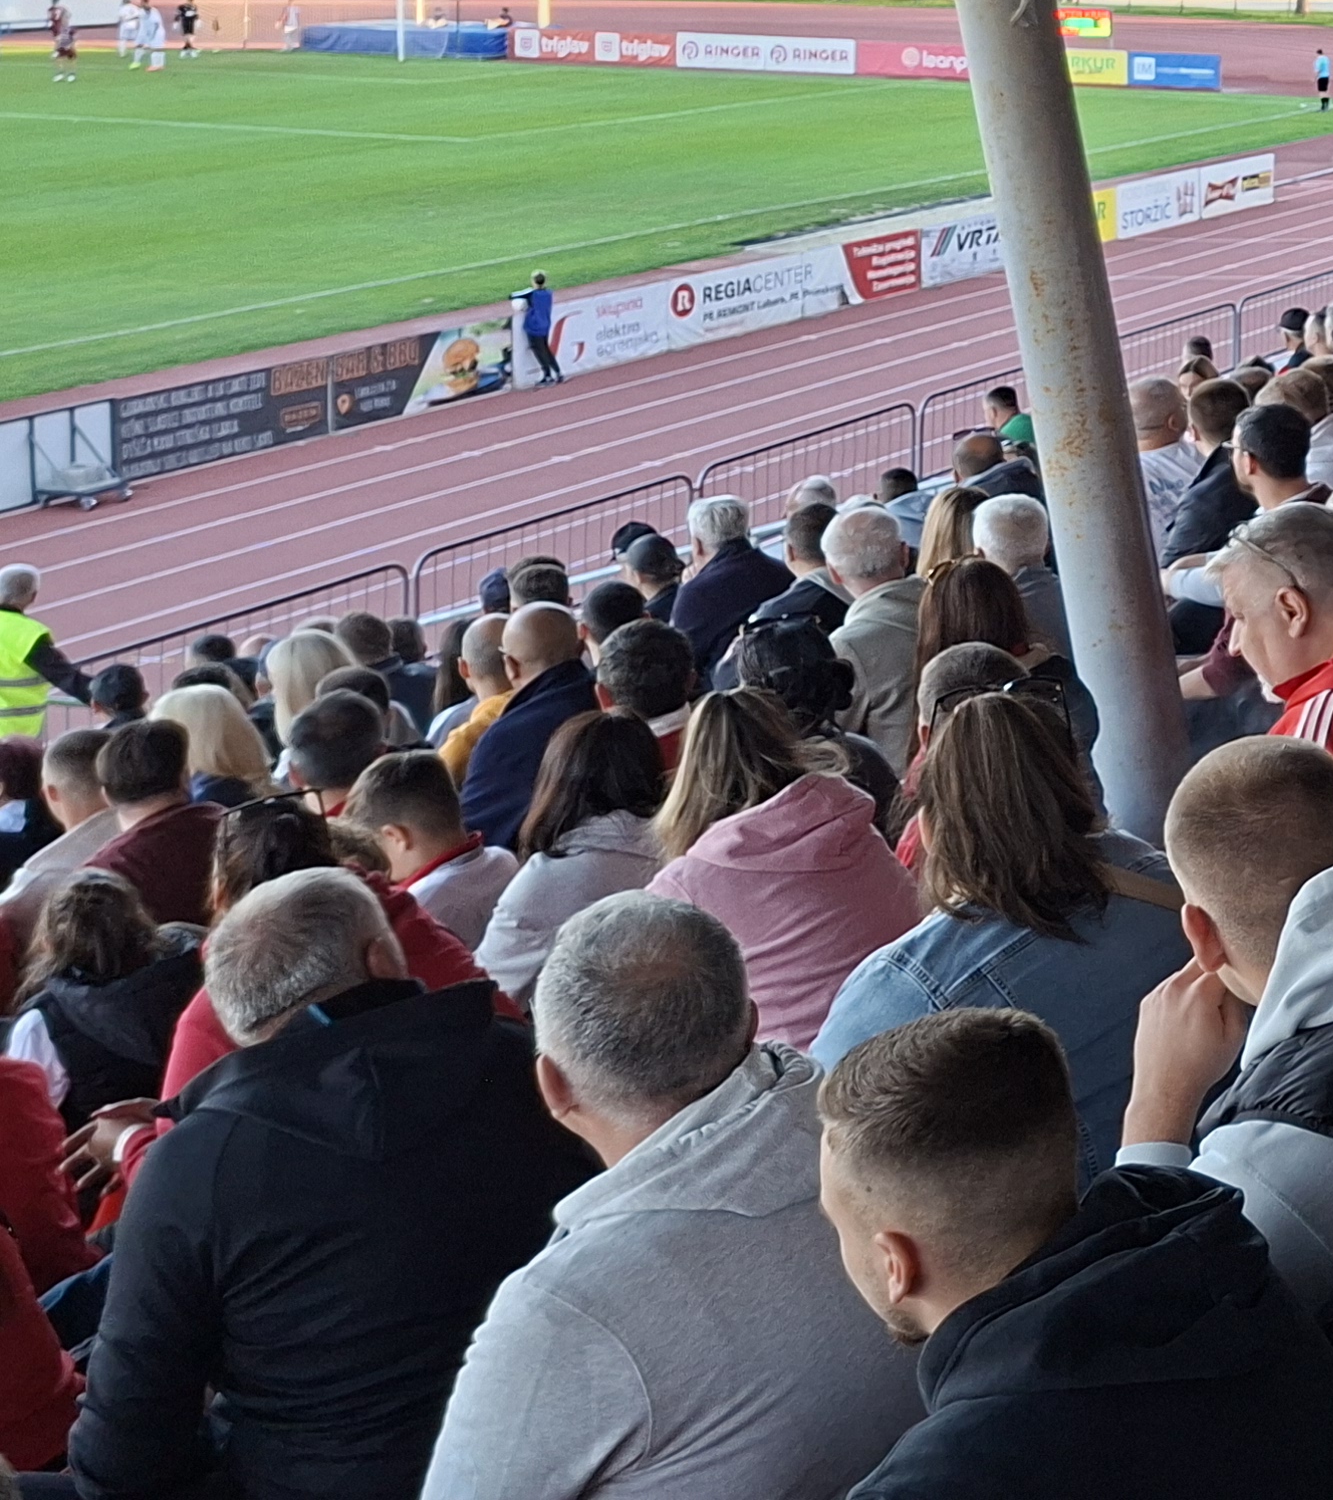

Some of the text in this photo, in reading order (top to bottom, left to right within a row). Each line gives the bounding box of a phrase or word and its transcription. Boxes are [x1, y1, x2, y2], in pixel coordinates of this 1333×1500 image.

[541, 35, 590, 58] triglav
[621, 38, 671, 61] triglav
[704, 44, 760, 58] RINGER
[792, 47, 848, 62] RINGER
[922, 49, 969, 74] leanp
[1071, 55, 1116, 71] RKUR
[1121, 196, 1172, 230] STORŽIČ
